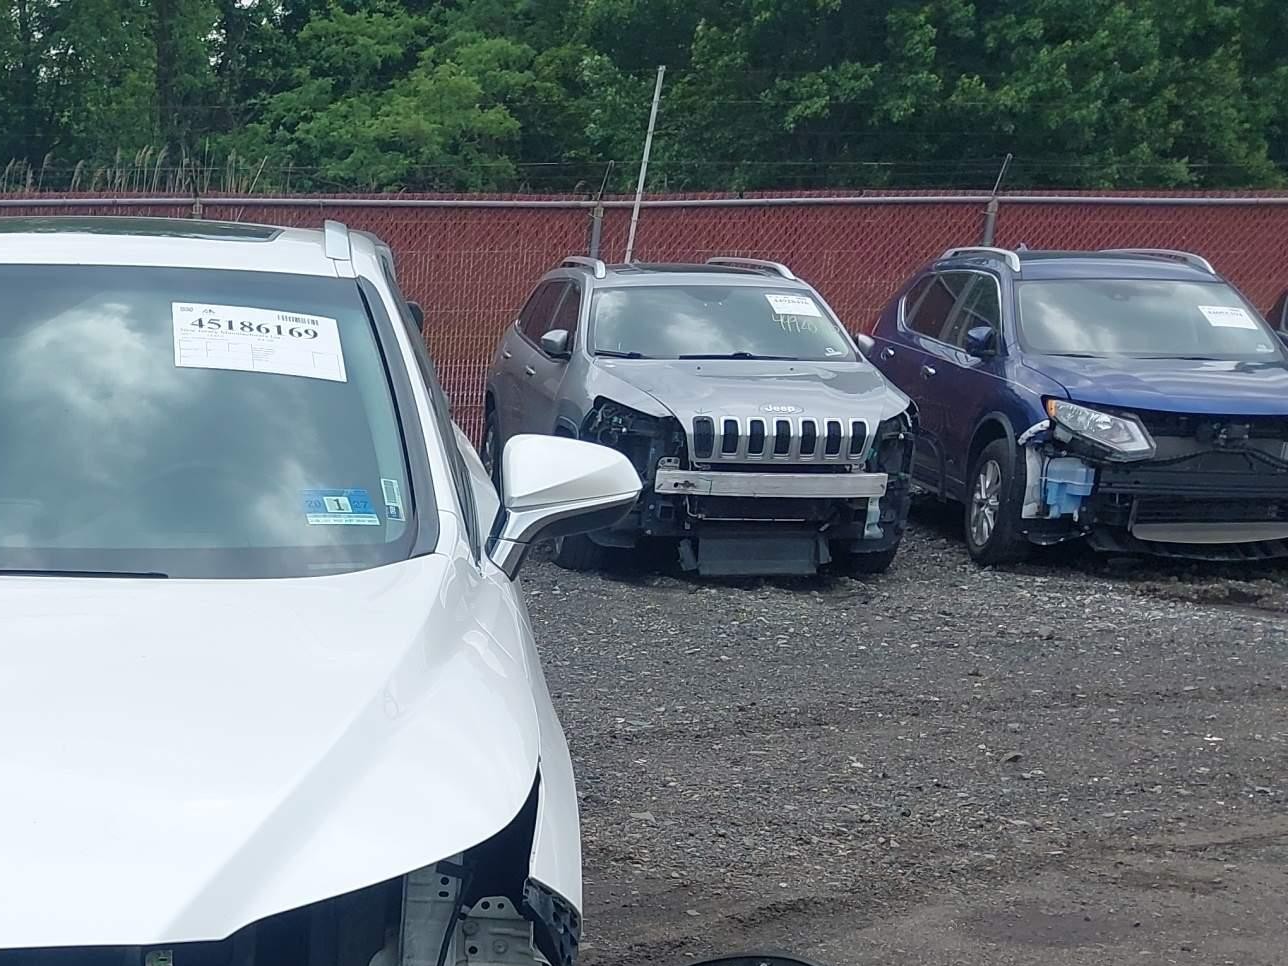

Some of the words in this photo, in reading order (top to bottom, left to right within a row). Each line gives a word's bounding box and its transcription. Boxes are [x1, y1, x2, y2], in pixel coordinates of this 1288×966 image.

[190, 316, 319, 340] 45186169
[764, 403, 797, 413] Jeep
[333, 498, 345, 511] 1
